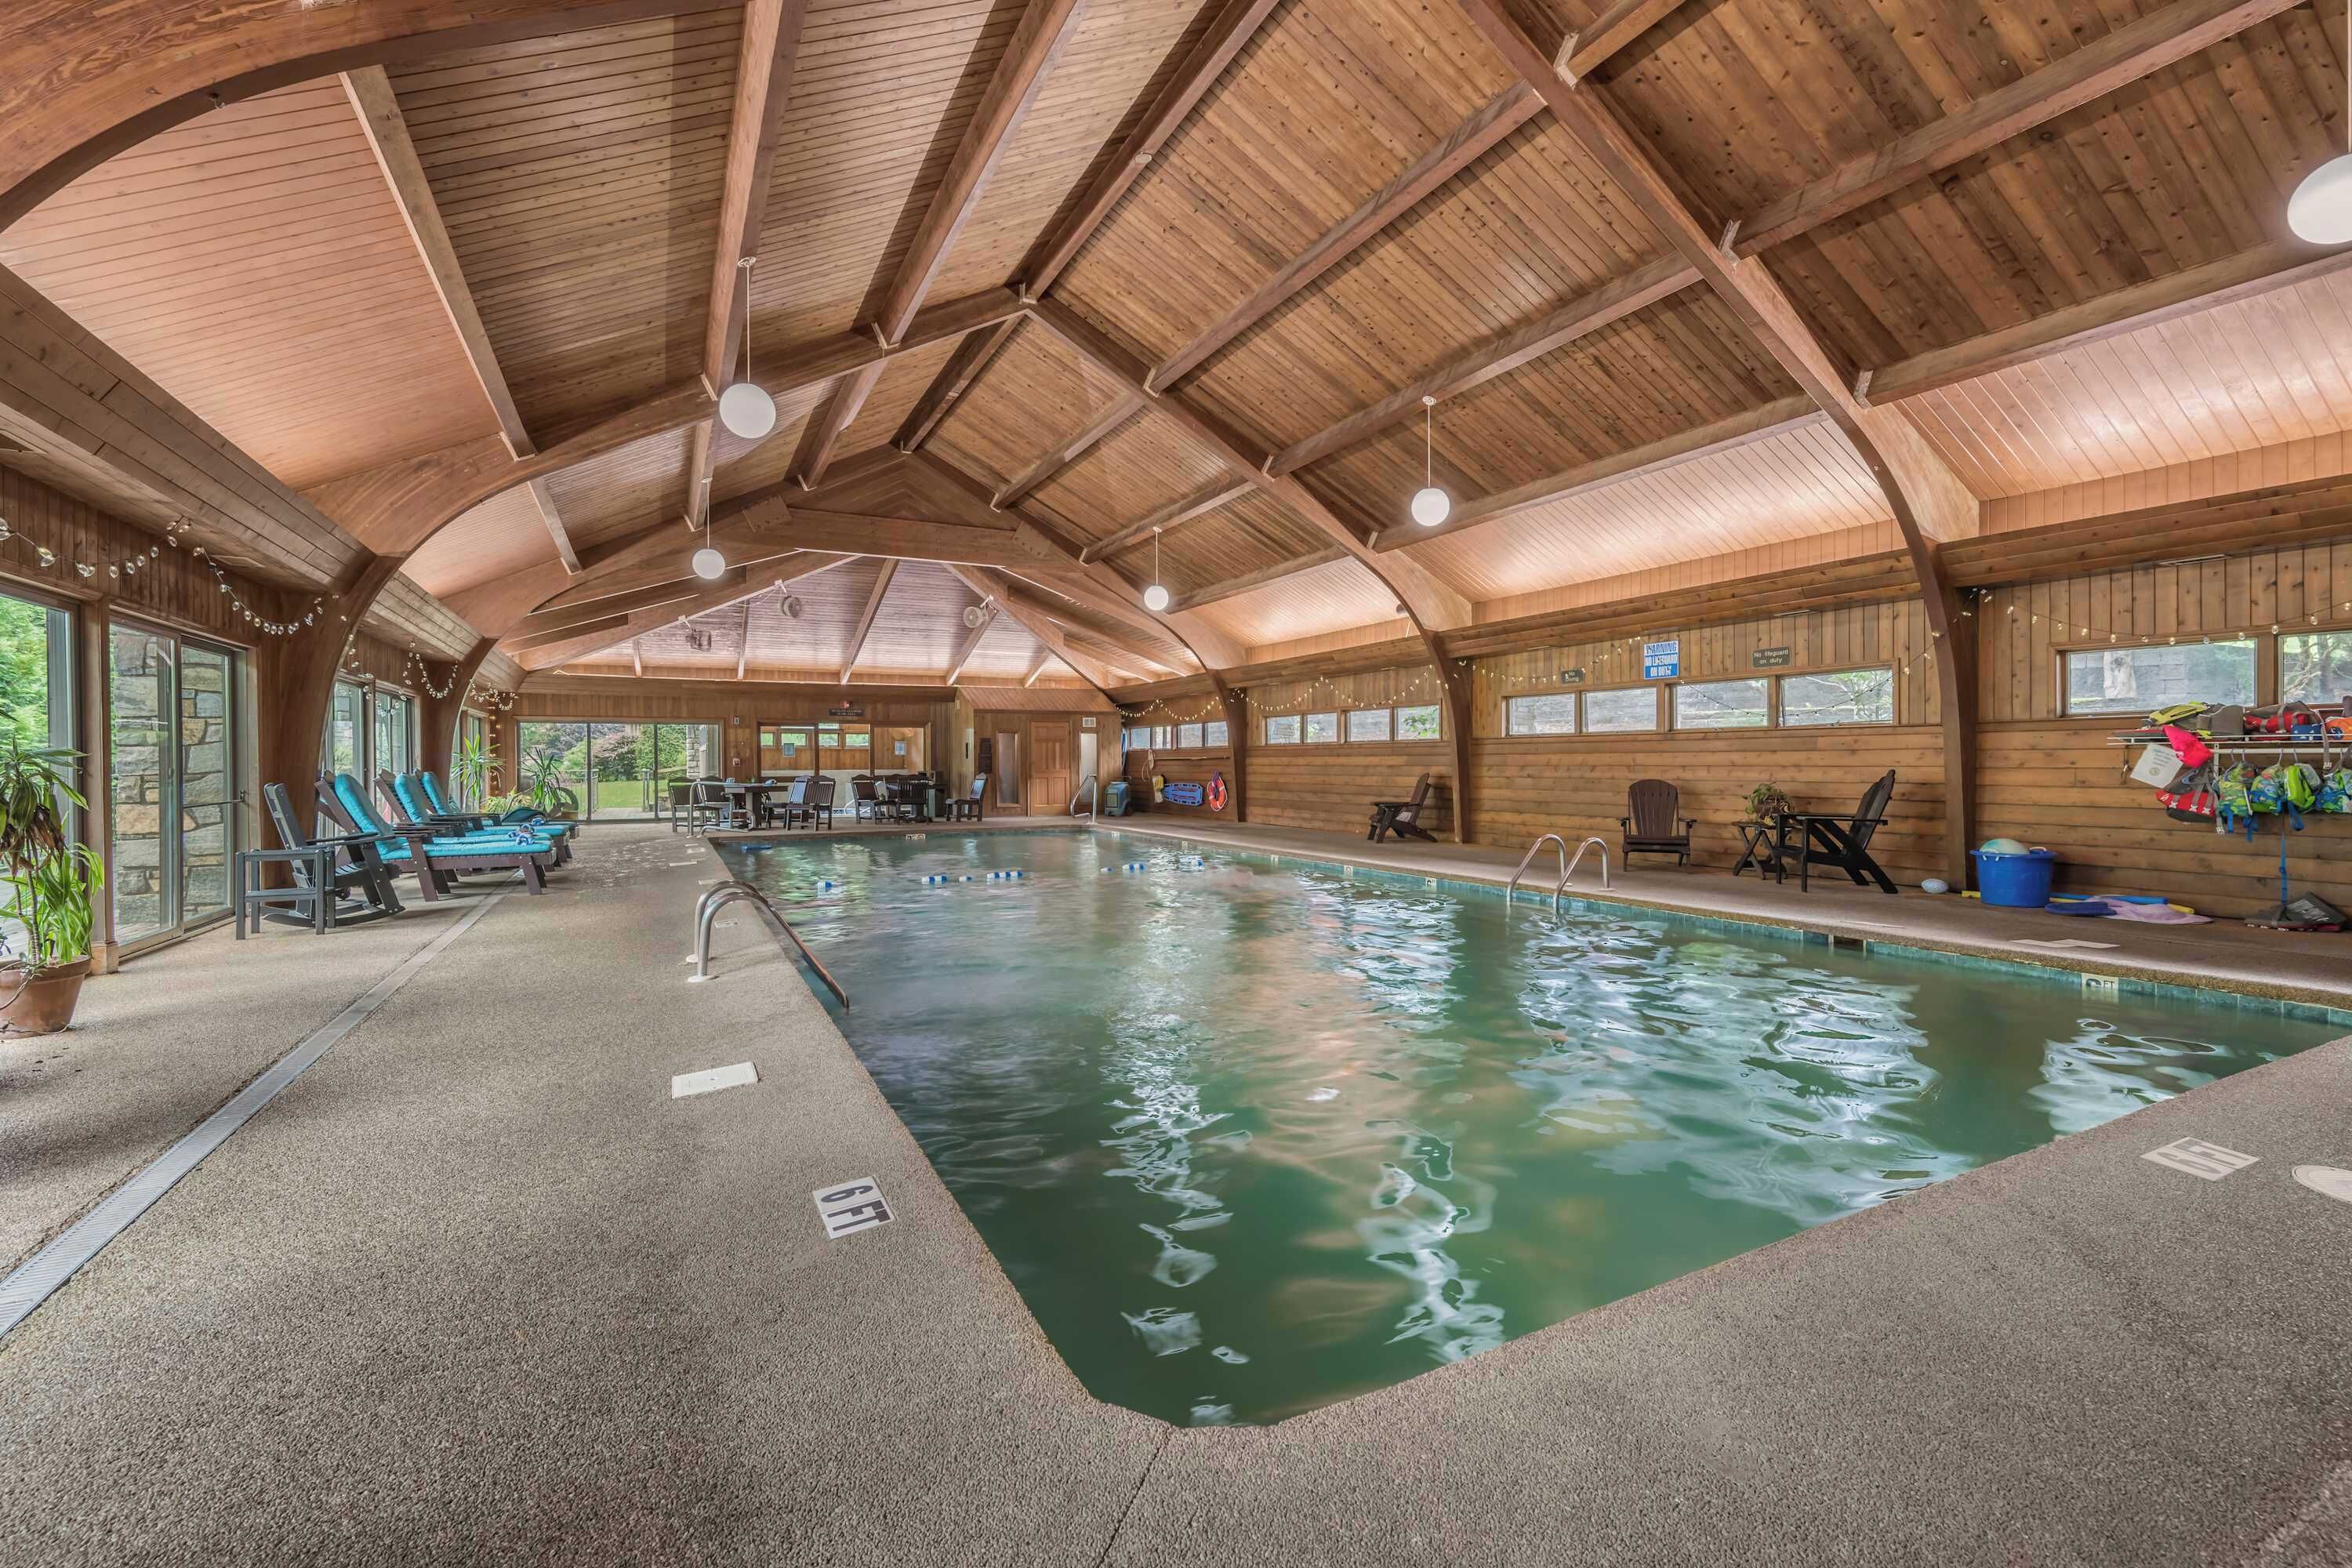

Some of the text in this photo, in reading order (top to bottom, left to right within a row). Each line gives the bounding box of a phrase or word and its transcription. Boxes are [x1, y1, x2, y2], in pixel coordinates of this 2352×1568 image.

[1646, 642, 1677, 655] WARNING
[1658, 665, 1672, 677] DUTY
[2171, 1138, 2250, 1167] FT
[820, 1185, 891, 1232] 6 FT
